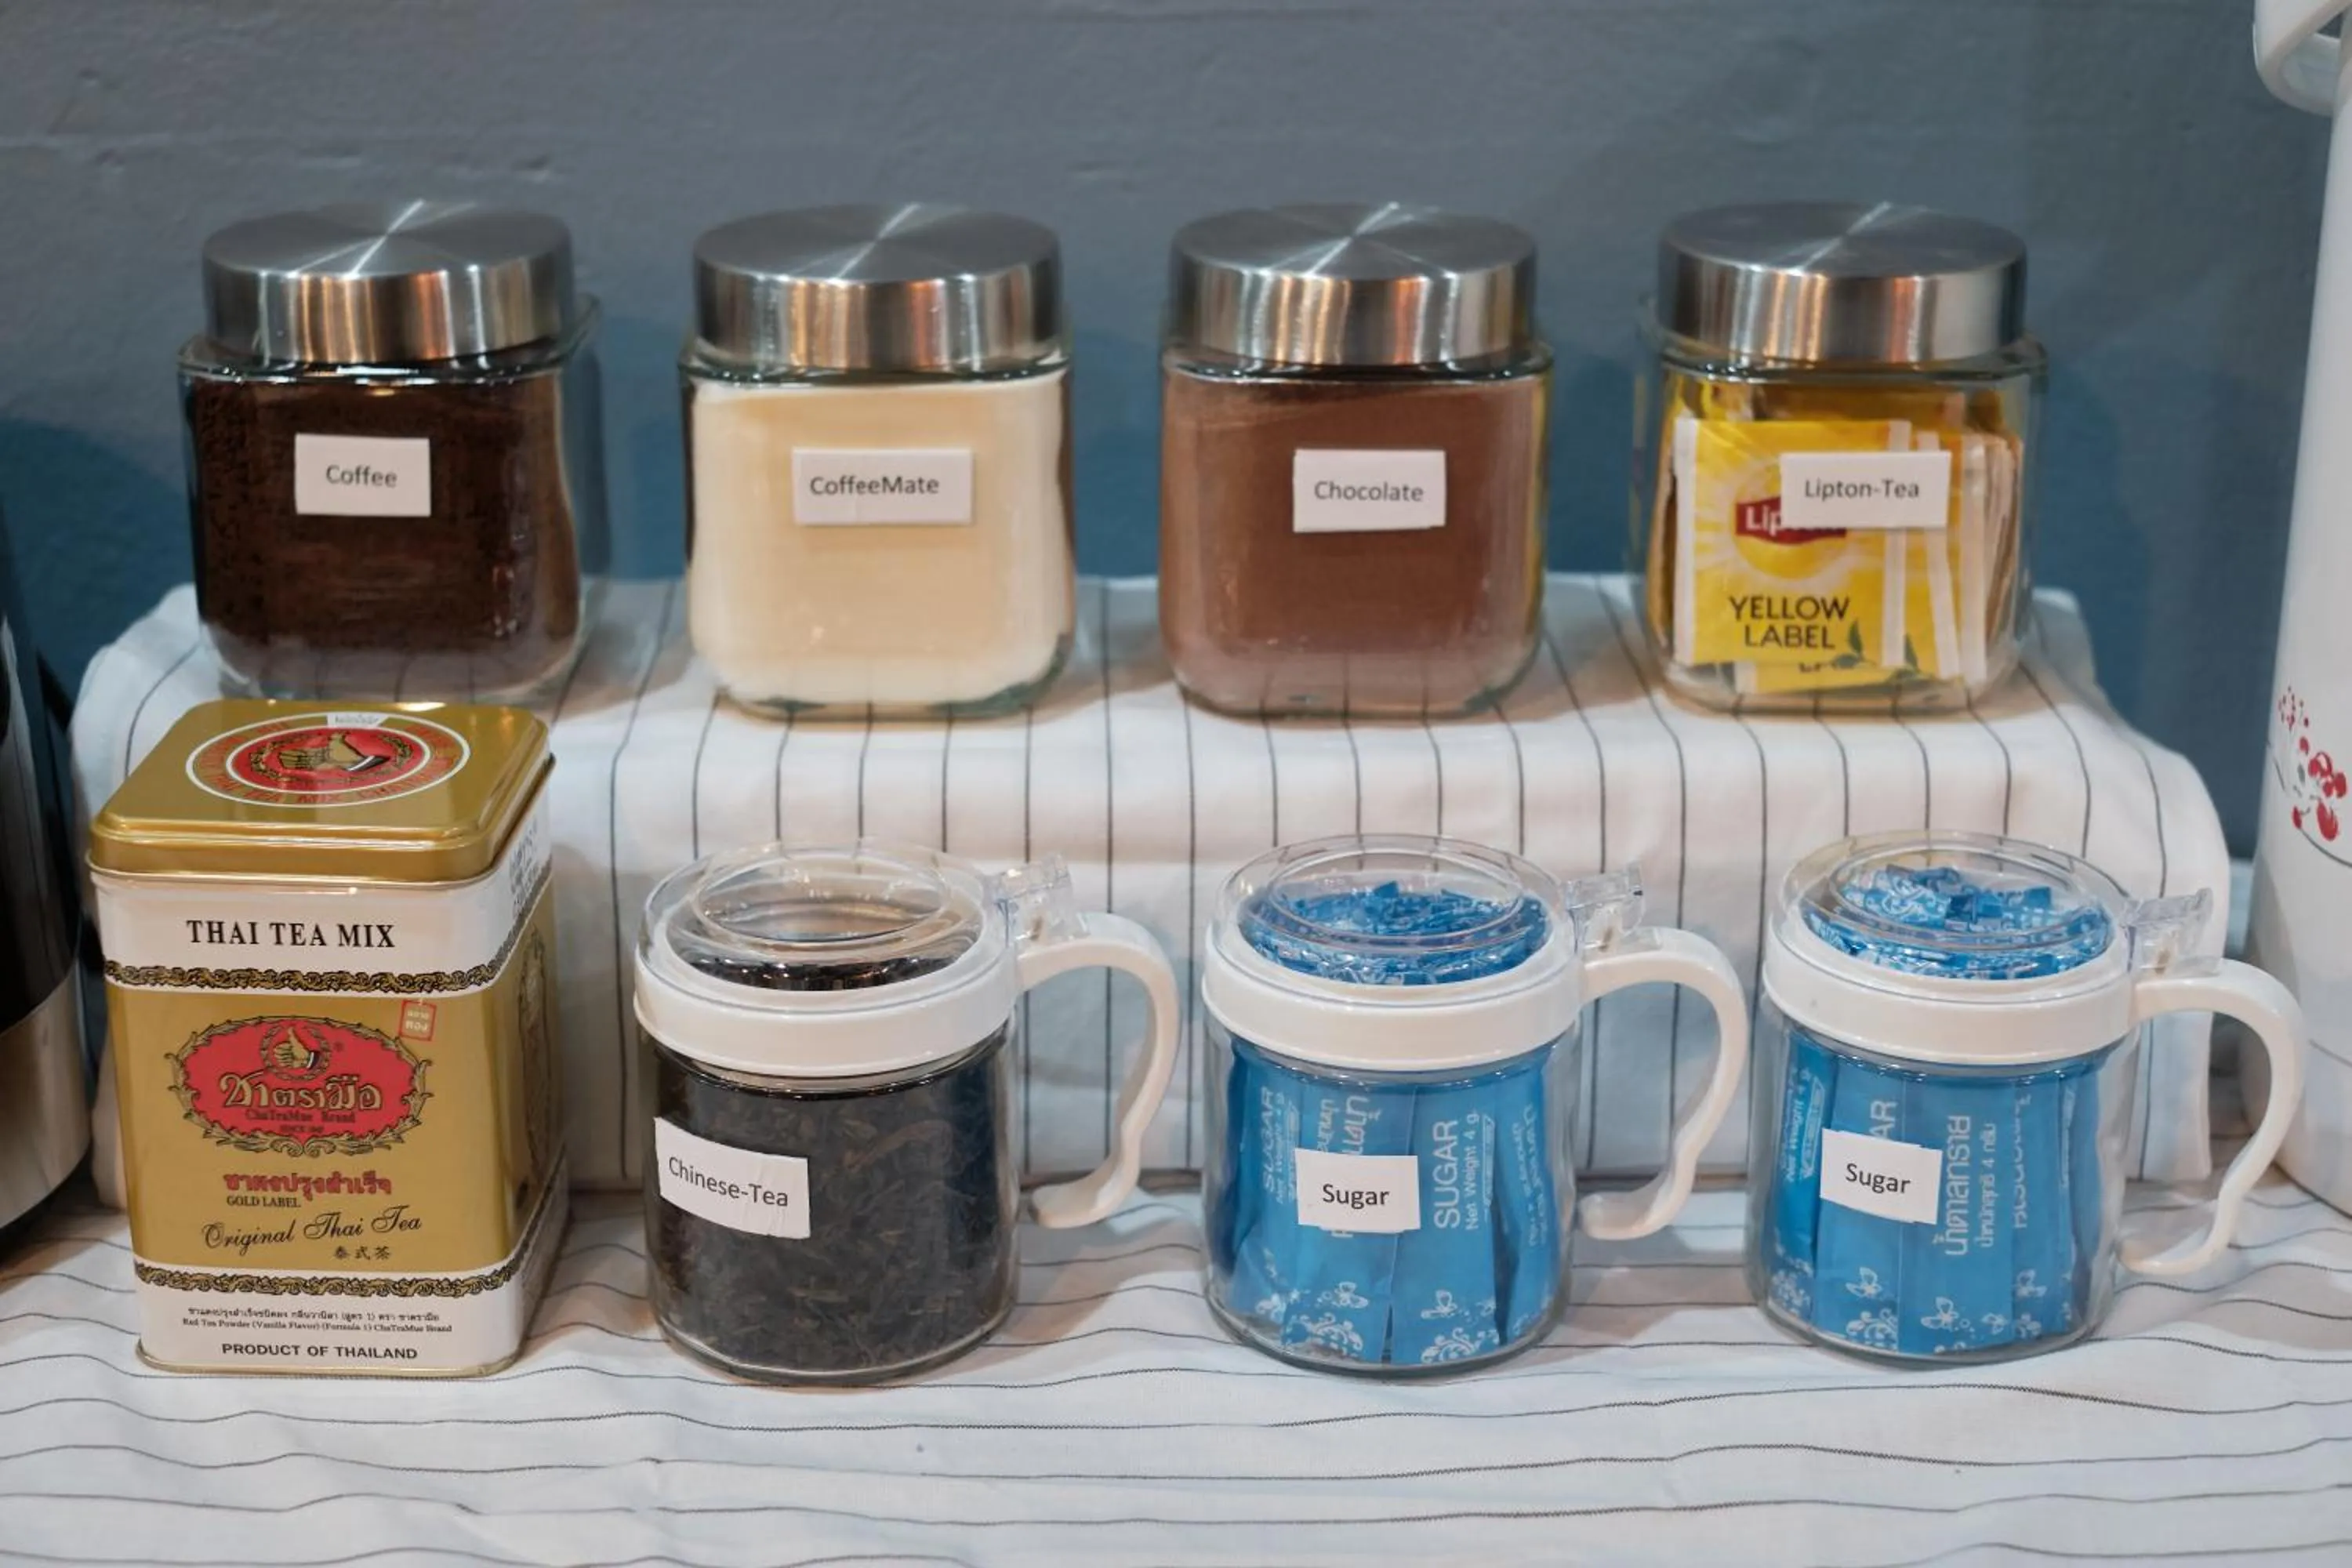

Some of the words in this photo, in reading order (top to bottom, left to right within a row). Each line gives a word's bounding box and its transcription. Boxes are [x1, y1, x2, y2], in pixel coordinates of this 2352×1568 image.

[325, 463, 397, 488] Coffee
[809, 474, 940, 495] CoffeeMate
[1314, 481, 1425, 502] Chocolate
[1804, 477, 1920, 502] Lipton-Tea
[1729, 595, 1851, 622] YELLOW
[1743, 624, 1836, 650] LABEL
[186, 920, 260, 946] THAI
[268, 922, 328, 948] TEA
[338, 924, 396, 949] MIX
[219, 1069, 383, 1111] ชาตรามือ
[1466, 1112, 1480, 1124] g
[1462, 1130, 1475, 1140] 4
[1432, 1120, 1461, 1229] SUGAR
[1464, 1145, 1479, 1198] Weight
[1982, 1158, 1994, 1169] 4
[668, 1156, 789, 1207] Chinese-Tea
[1846, 1162, 1911, 1194] Sugar
[1932, 1116, 1971, 1256] น้ำตาลทราย
[227, 1196, 260, 1207] GOLD
[263, 1196, 301, 1208] LABEL
[1322, 1182, 1390, 1210] Sugar
[1465, 1203, 1479, 1230] Net
[201, 1219, 297, 1256] Original
[303, 1211, 364, 1240] Thai
[371, 1205, 422, 1233] Tea
[222, 1342, 300, 1356] PRODUCT
[307, 1345, 329, 1357] OF
[334, 1345, 419, 1359] THAILAND
